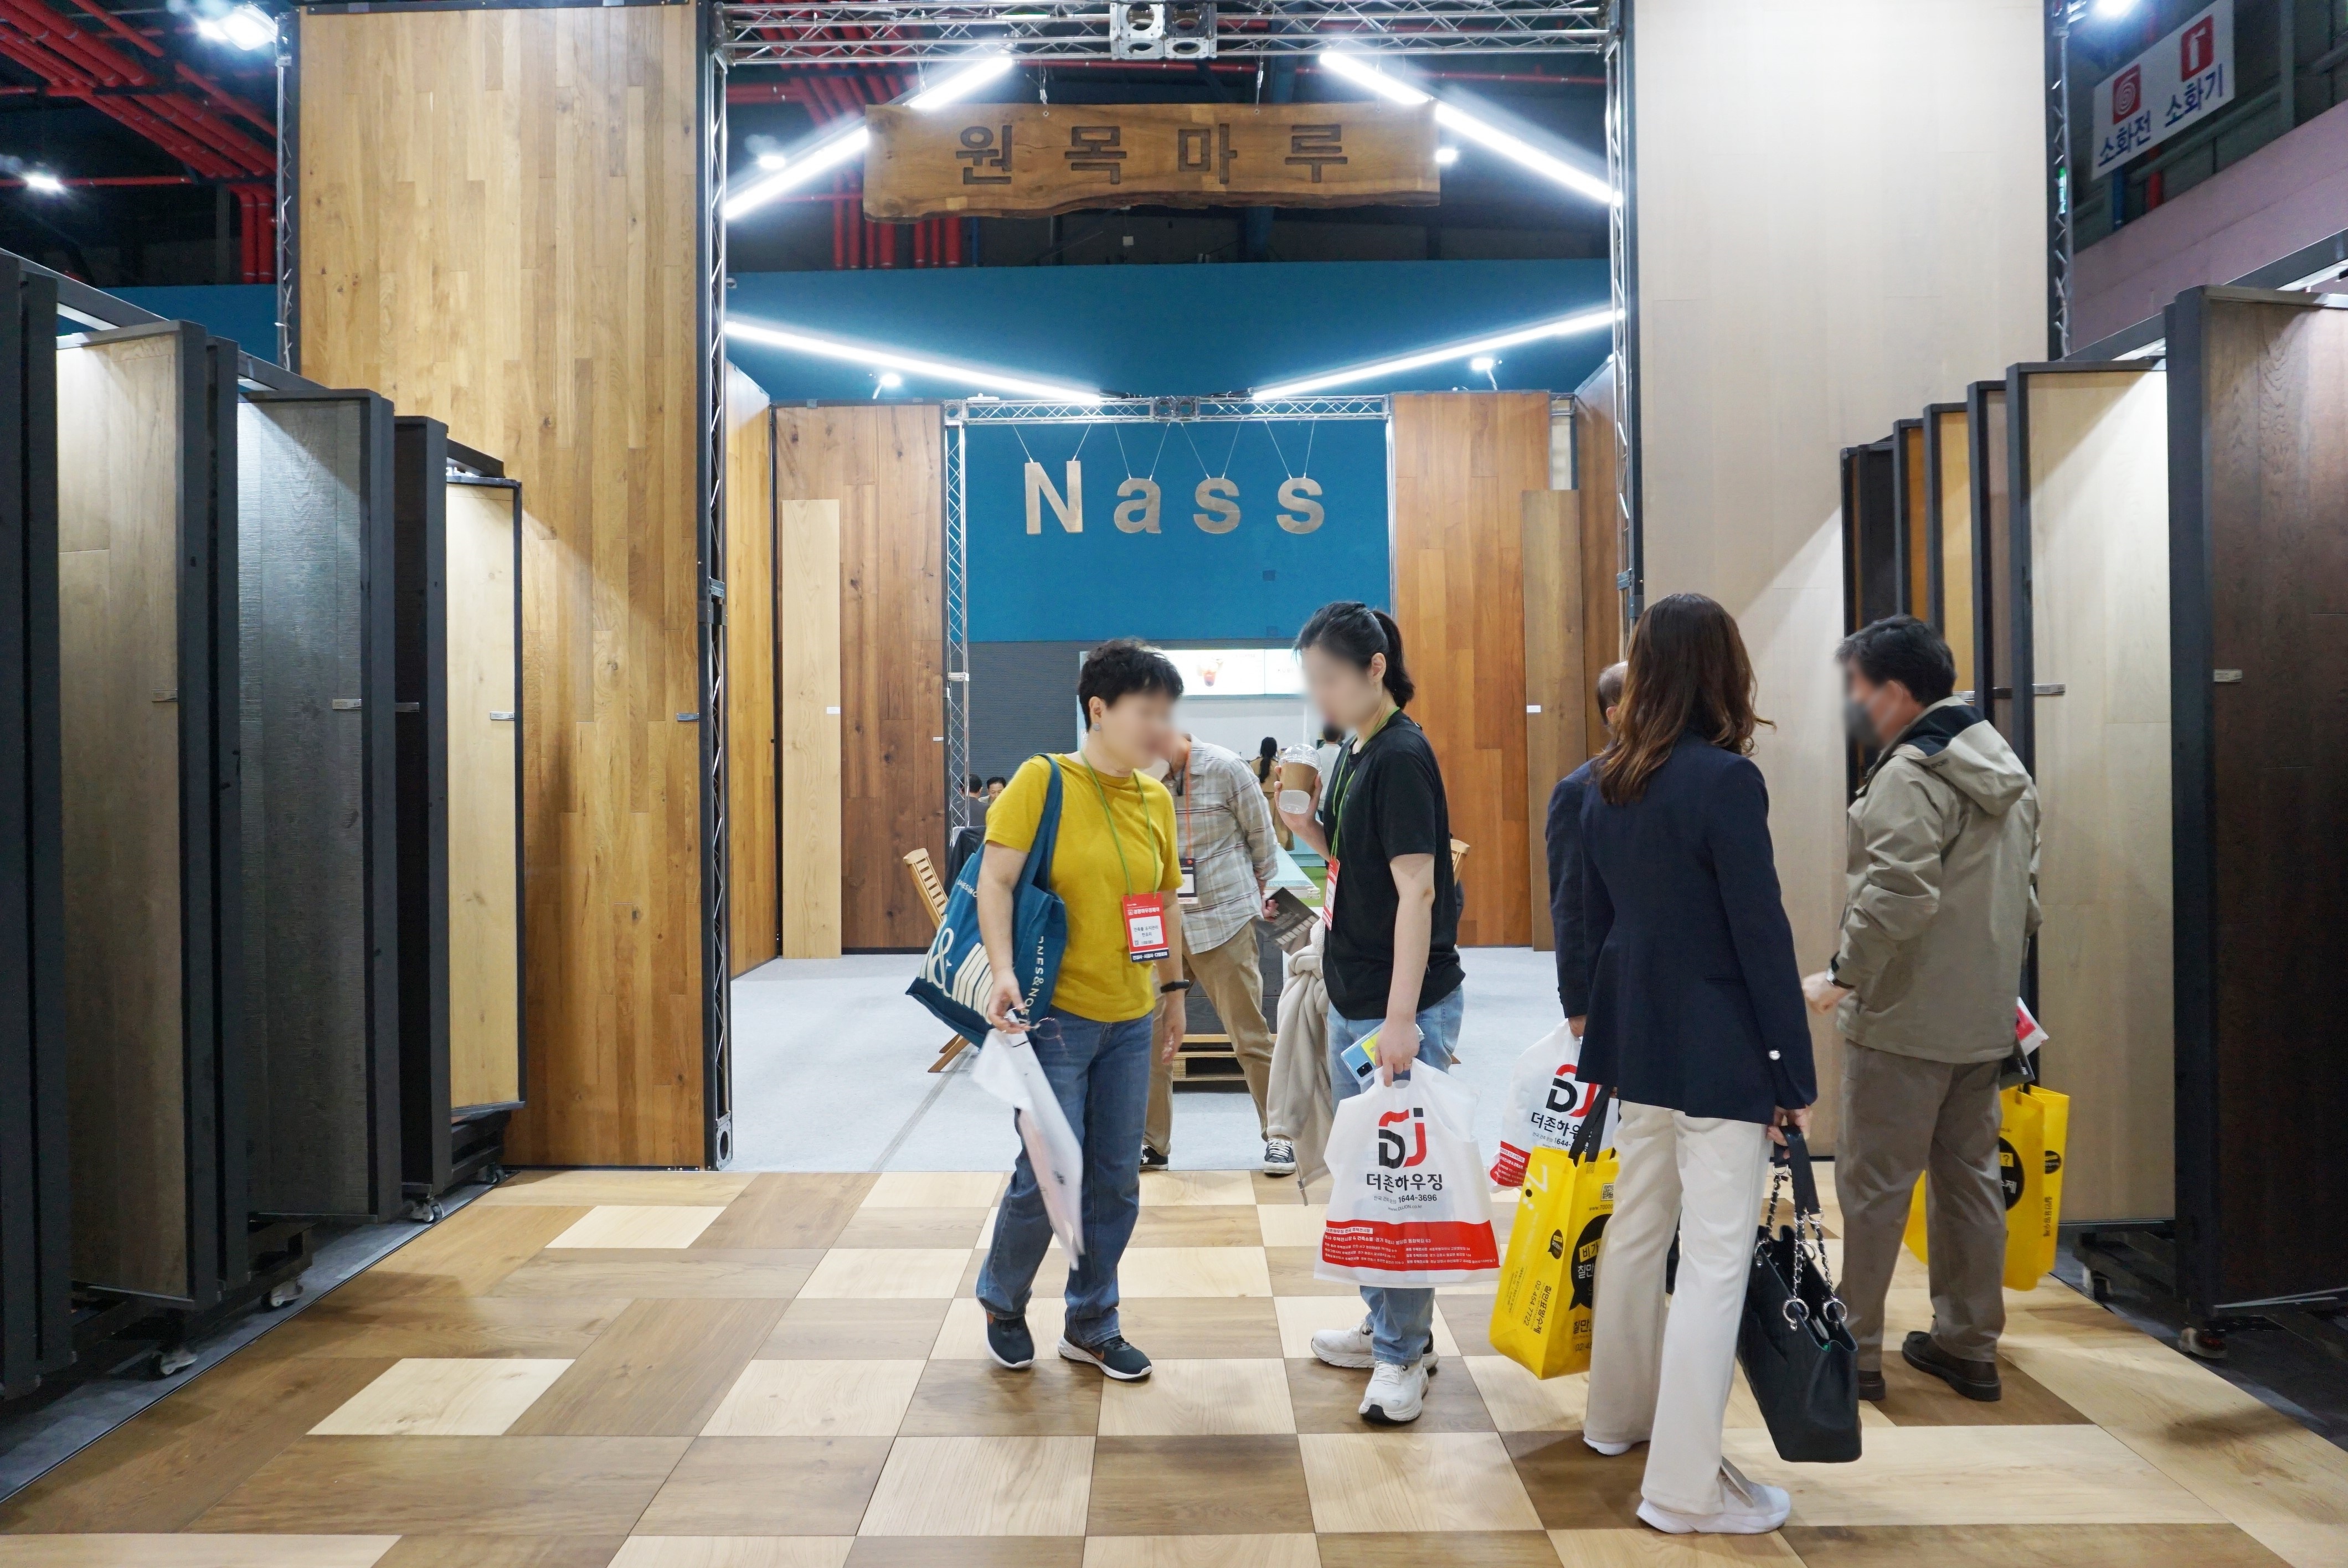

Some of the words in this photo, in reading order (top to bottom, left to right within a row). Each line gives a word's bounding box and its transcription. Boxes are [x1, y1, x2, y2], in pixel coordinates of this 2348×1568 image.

[2165, 63, 2223, 128] 소화기
[956, 123, 1348, 184] 원목마루
[2098, 110, 2151, 167] 소화전
[1024, 461, 1325, 534] Nass
[1367, 1173, 1443, 1193] 더존하우징
[1398, 1194, 1437, 1203] 1644-3696
[1533, 1286, 1552, 1334] 칠만표방수제
